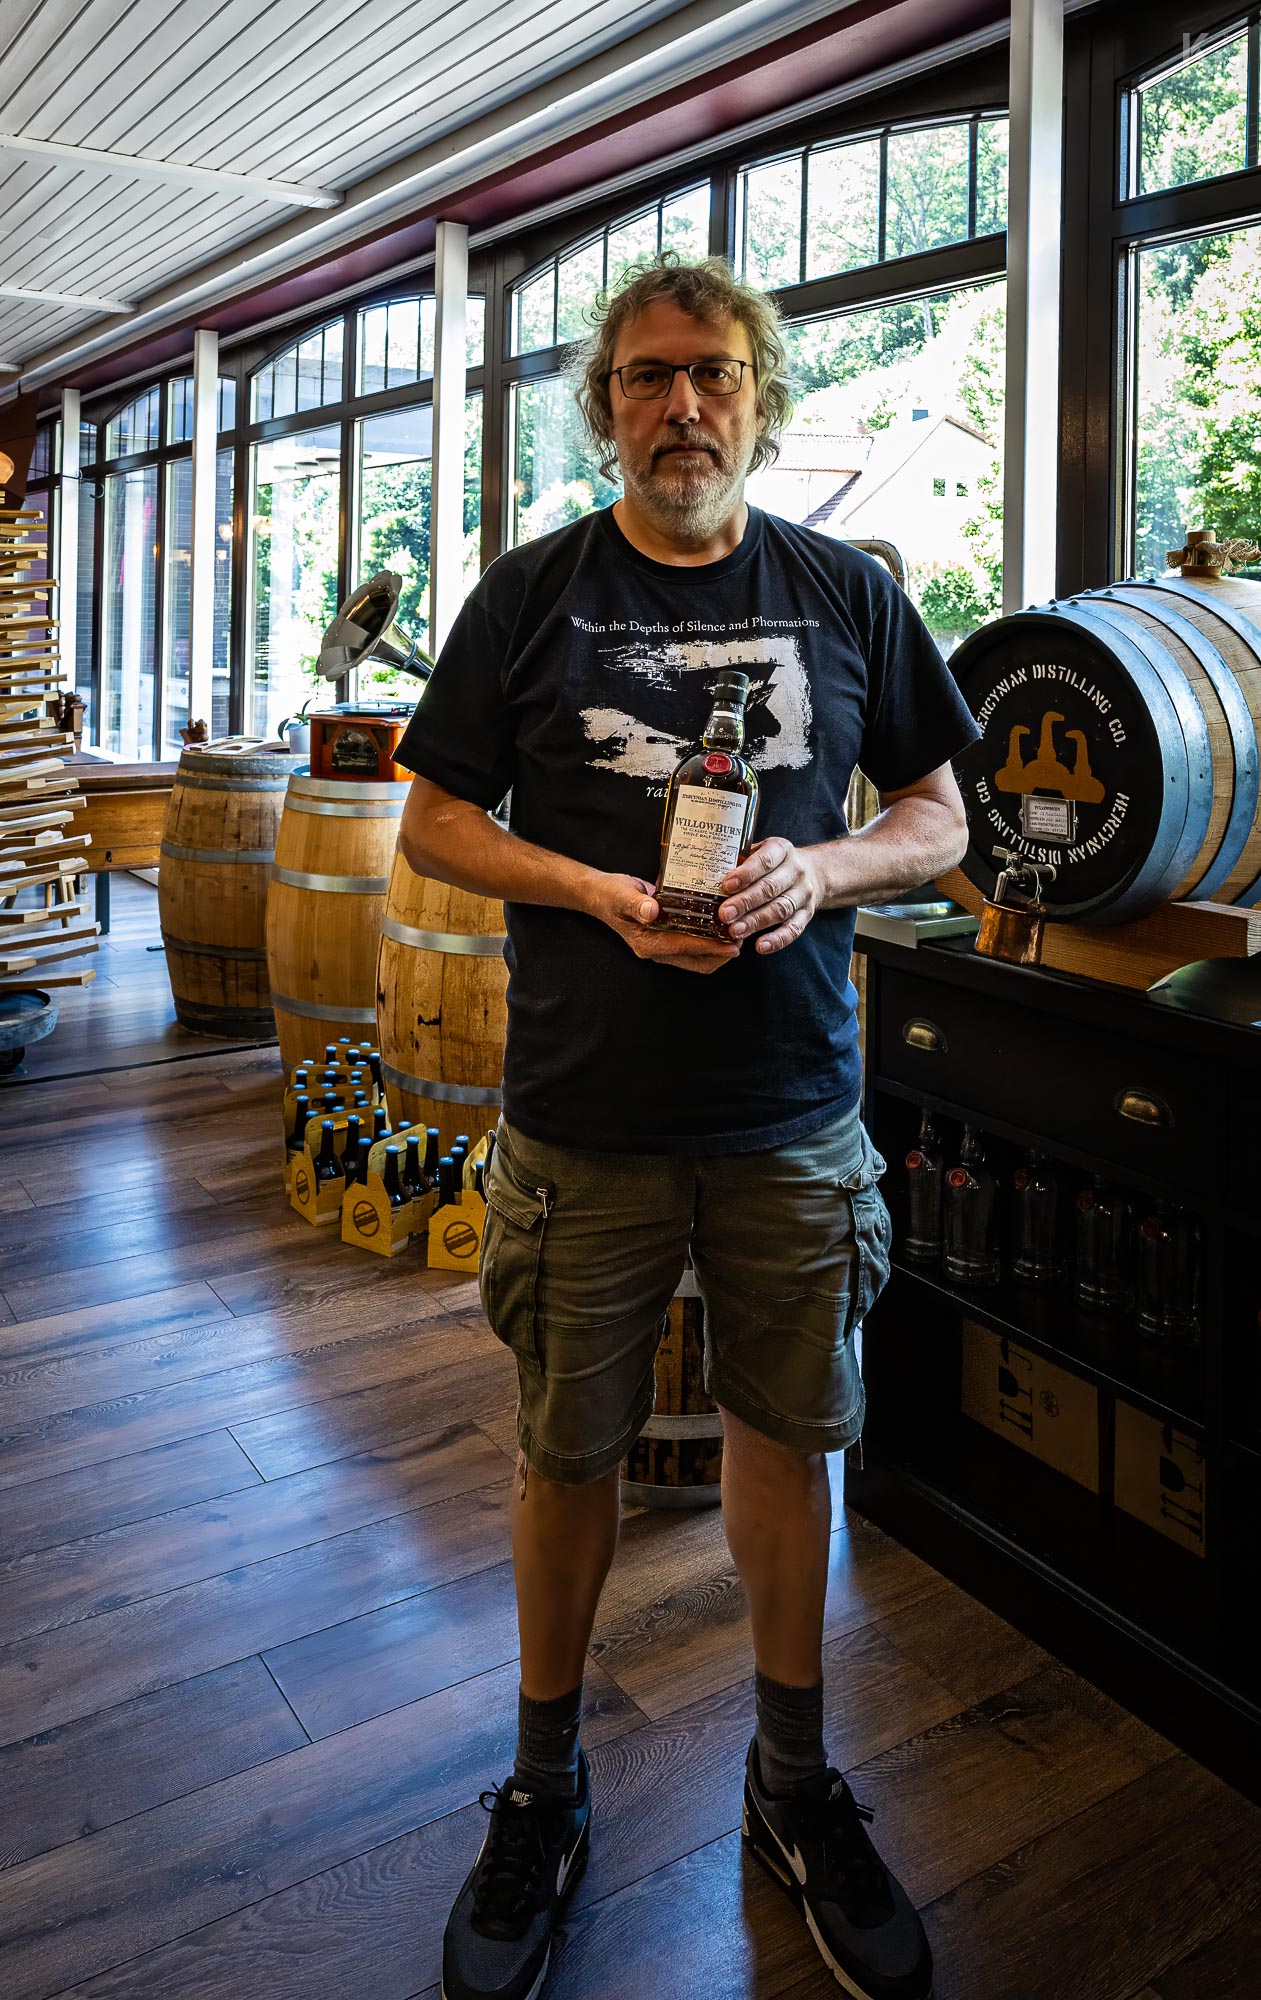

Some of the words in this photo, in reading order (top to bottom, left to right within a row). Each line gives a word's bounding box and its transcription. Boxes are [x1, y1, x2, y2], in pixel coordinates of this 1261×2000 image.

[570, 615, 607, 633] Within
[608, 620, 627, 632] the
[628, 620, 670, 636] Depths
[672, 620, 685, 633] of
[687, 619, 726, 632] Silence
[728, 618, 749, 631] and
[751, 616, 821, 630] Phormations
[976, 667, 1028, 740] ERCYNIAN
[1032, 664, 1113, 714] DISTILLING
[1108, 718, 1127, 749] CO.
[987, 809, 1062, 866] DISTILLING
[1067, 791, 1131, 864] HERCYNIAN
[509, 1789, 531, 1804] NIKE
